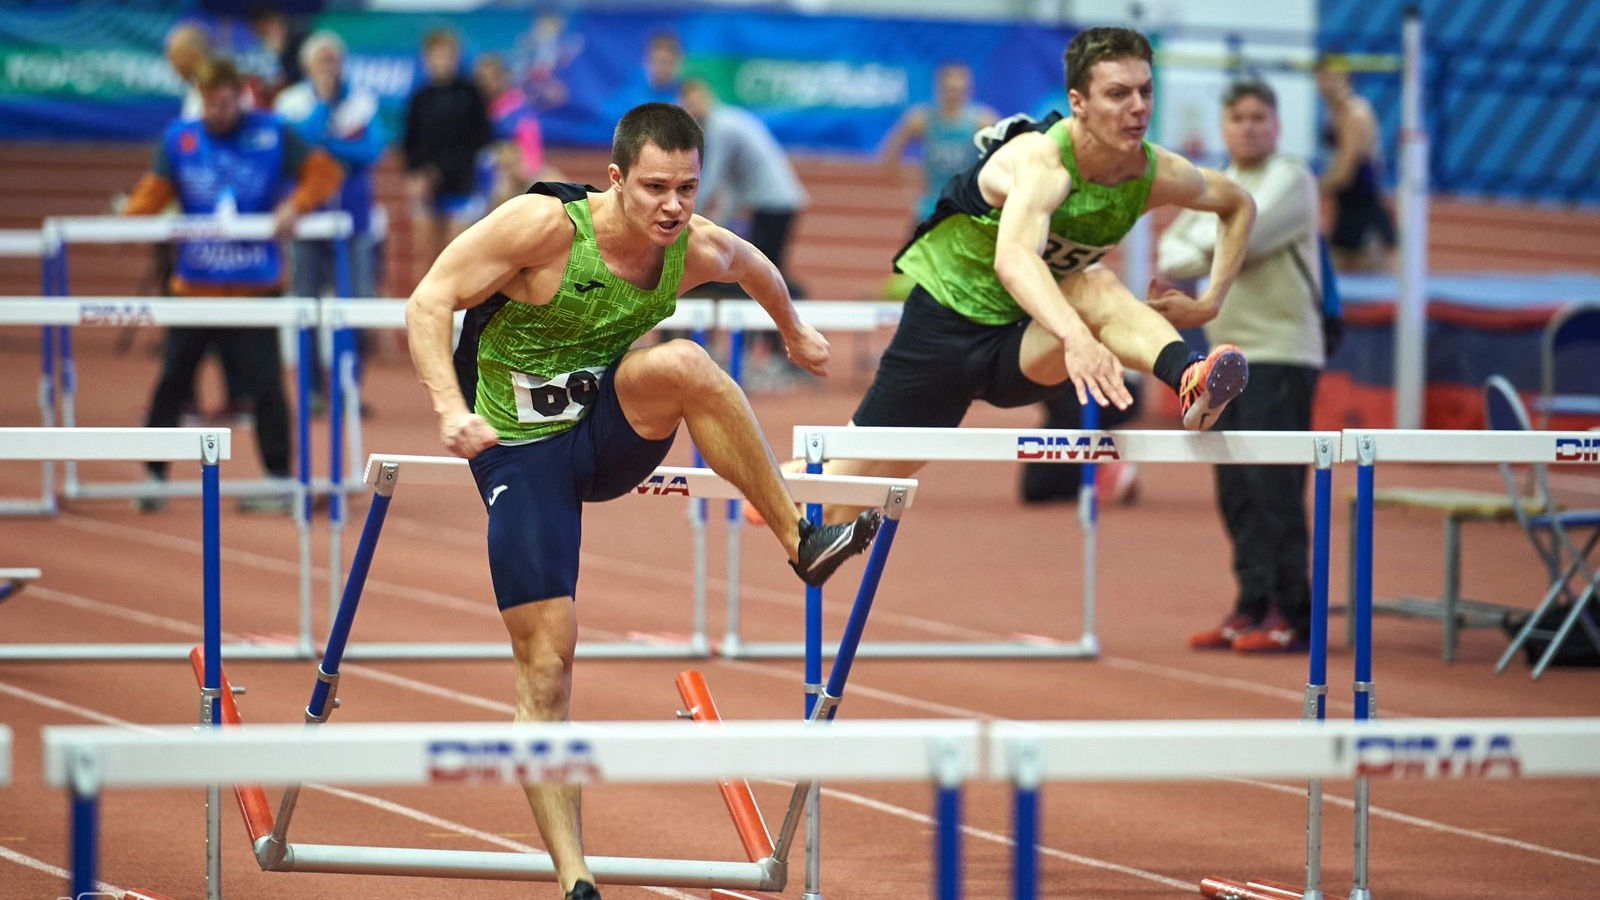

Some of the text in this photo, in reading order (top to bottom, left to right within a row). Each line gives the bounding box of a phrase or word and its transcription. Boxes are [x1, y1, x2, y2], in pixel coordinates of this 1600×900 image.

[1017, 436, 1120, 459] DIMA
[1556, 438, 1600, 460] DI
[636, 475, 689, 496] MA
[428, 740, 603, 781] DIMA
[1356, 735, 1521, 777] DIMA
